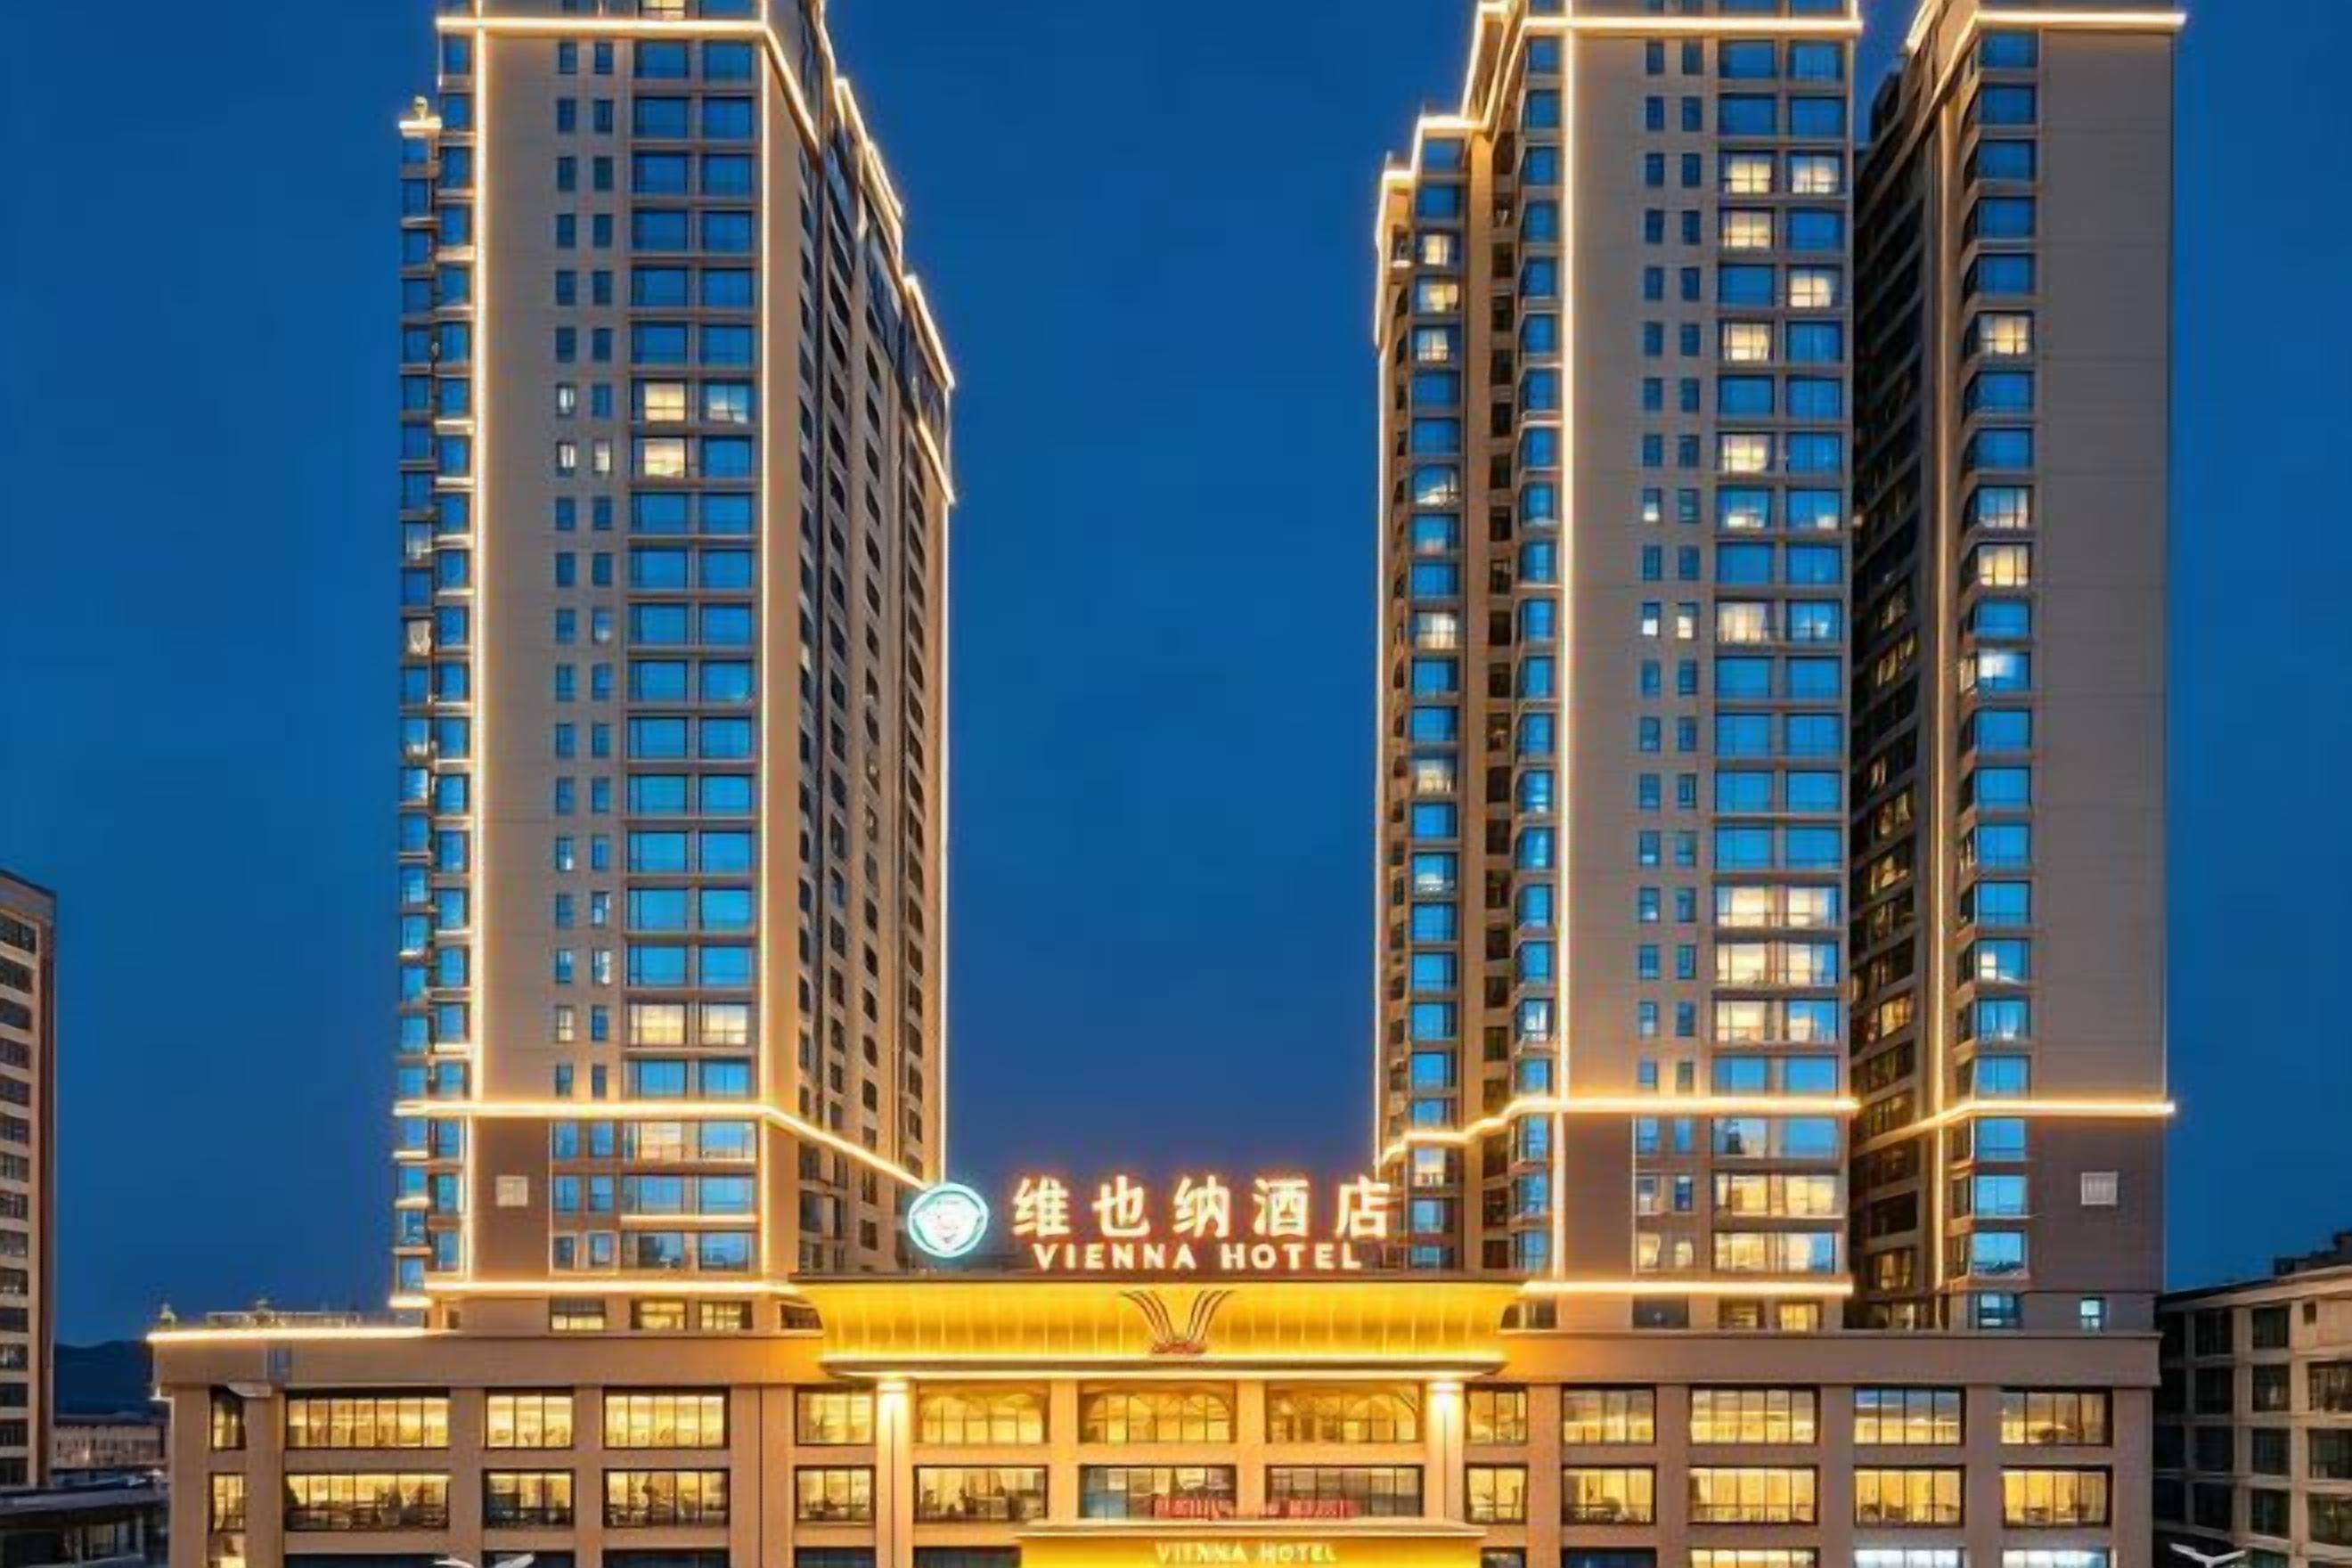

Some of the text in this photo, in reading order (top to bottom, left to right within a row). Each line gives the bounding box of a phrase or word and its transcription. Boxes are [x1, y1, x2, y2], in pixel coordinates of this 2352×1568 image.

[1012, 1175, 1391, 1237] 维也纳酒店
[1033, 1243, 1362, 1270] VIENNA HOTEL
[1261, 1541, 1336, 1563] HOTEL
